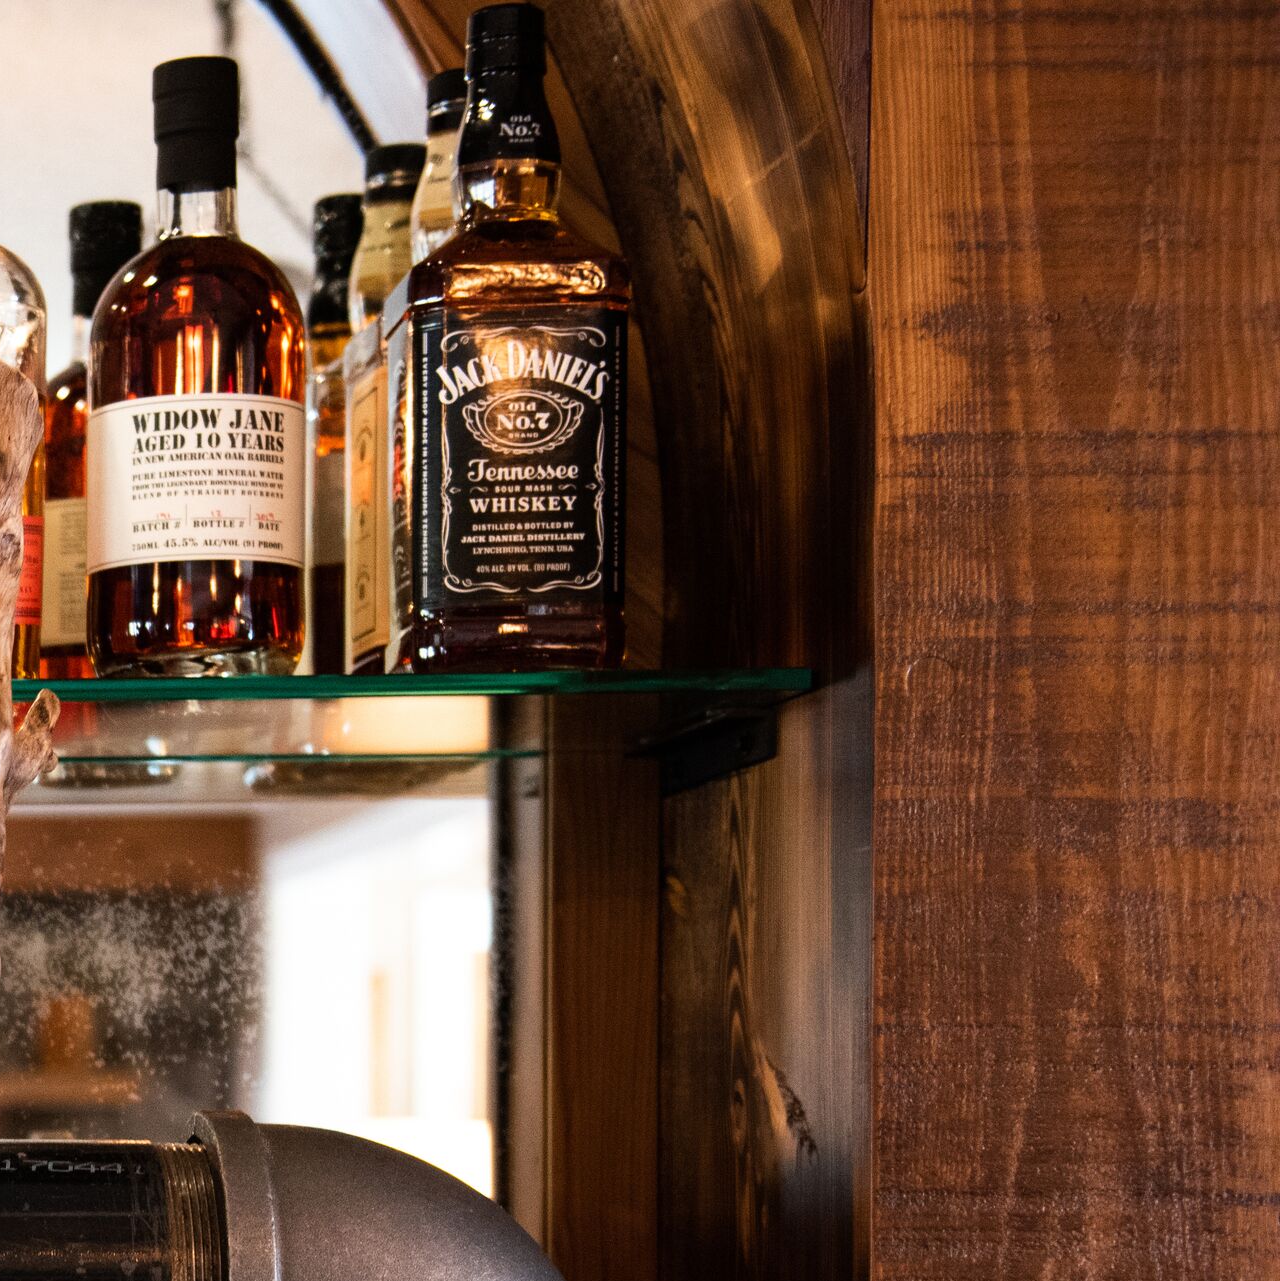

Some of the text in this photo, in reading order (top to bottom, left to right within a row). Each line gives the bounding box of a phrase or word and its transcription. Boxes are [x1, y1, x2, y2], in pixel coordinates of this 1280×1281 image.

[498, 122, 541, 136] No.7
[436, 340, 610, 405] JACK DANIEL'S
[508, 402, 536, 412] Old
[132, 408, 284, 434] WIDOW JANE
[496, 413, 550, 431] No.7
[133, 433, 284, 454] AGED 10 YEARS
[132, 453, 284, 466] IN NEW AMERICAN OAK BARRELS
[132, 469, 284, 482] PURE LIMESTONE MINERAL WATER
[467, 458, 579, 482] Tennessee
[167, 480, 209, 488] LEGENDARY
[495, 485, 521, 493] SOUR
[132, 491, 162, 501] BLEND
[241, 489, 284, 499] BOURBONS
[469, 496, 577, 514] WHISKEY
[133, 520, 279, 533] BATCH BOTTLE DATE
[472, 523, 515, 532] DISTILLED
[524, 522, 562, 530] BOTTLED
[163, 538, 199, 548] 45.5%
[203, 539, 240, 547] ALC/VOL
[488, 534, 525, 543] DANIEL
[527, 533, 585, 541] DISTILLERY
[473, 547, 529, 555] LYNCHBURG,
[476, 565, 490, 573] 40%
[491, 564, 506, 572] ALC.
[517, 563, 532, 571] VOL.
[546, 563, 571, 571] PROOF)
